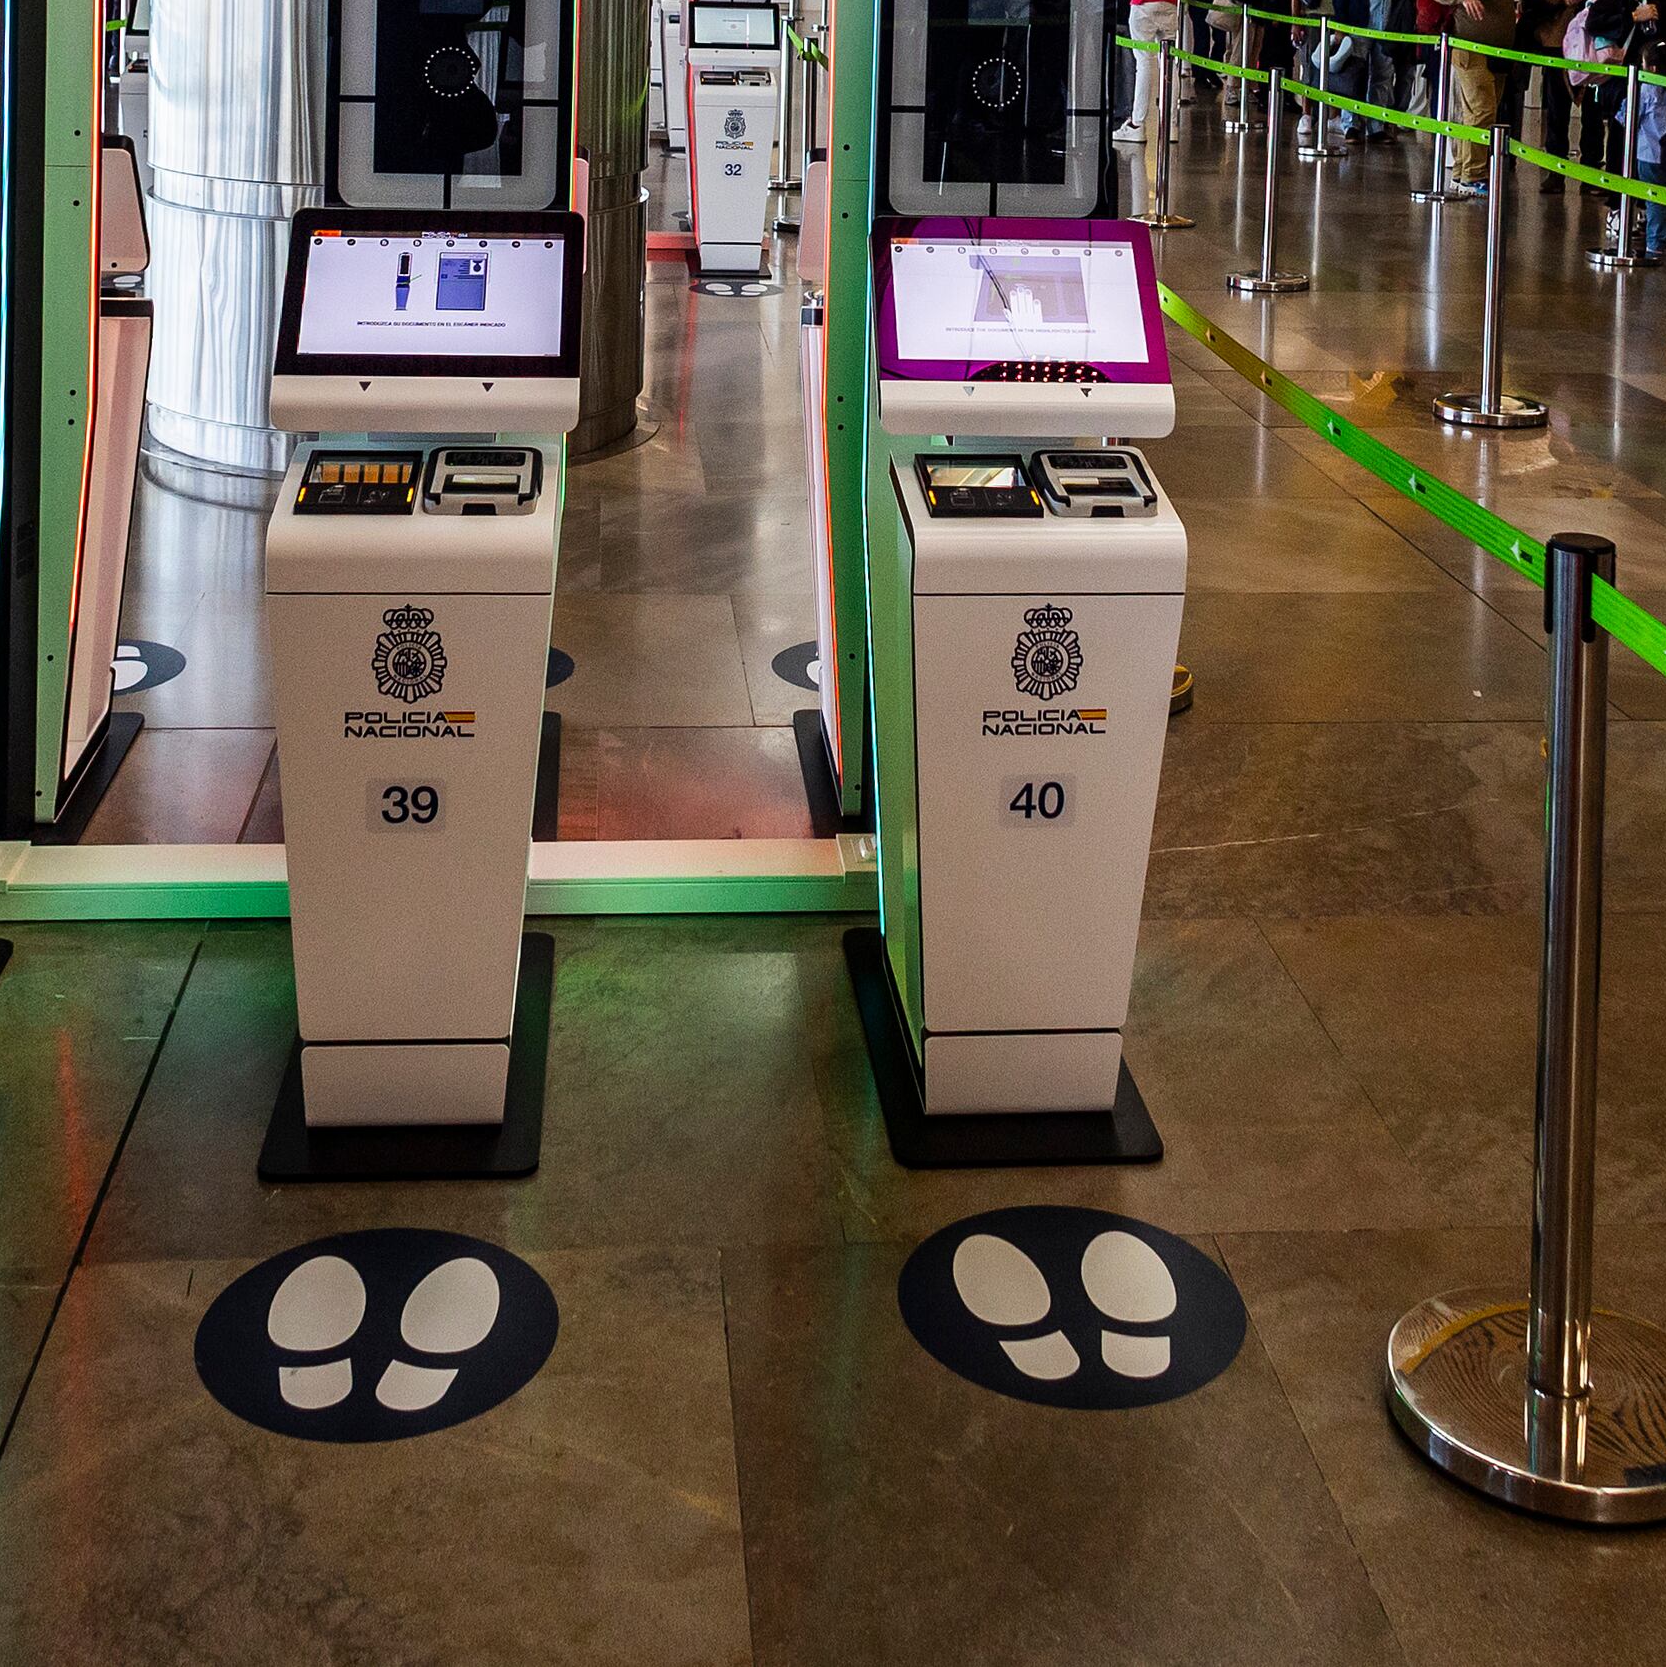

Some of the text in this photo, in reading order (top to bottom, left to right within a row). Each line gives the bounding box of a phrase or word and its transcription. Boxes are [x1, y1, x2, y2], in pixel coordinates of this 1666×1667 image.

[724, 163, 742, 176] 32
[344, 711, 448, 724] POLICIA
[982, 709, 1081, 722] POLICIA
[344, 725, 475, 738] NACIONAL
[982, 722, 1106, 736] NACIONAL
[381, 785, 439, 824] 39
[1009, 781, 1065, 819] 40
